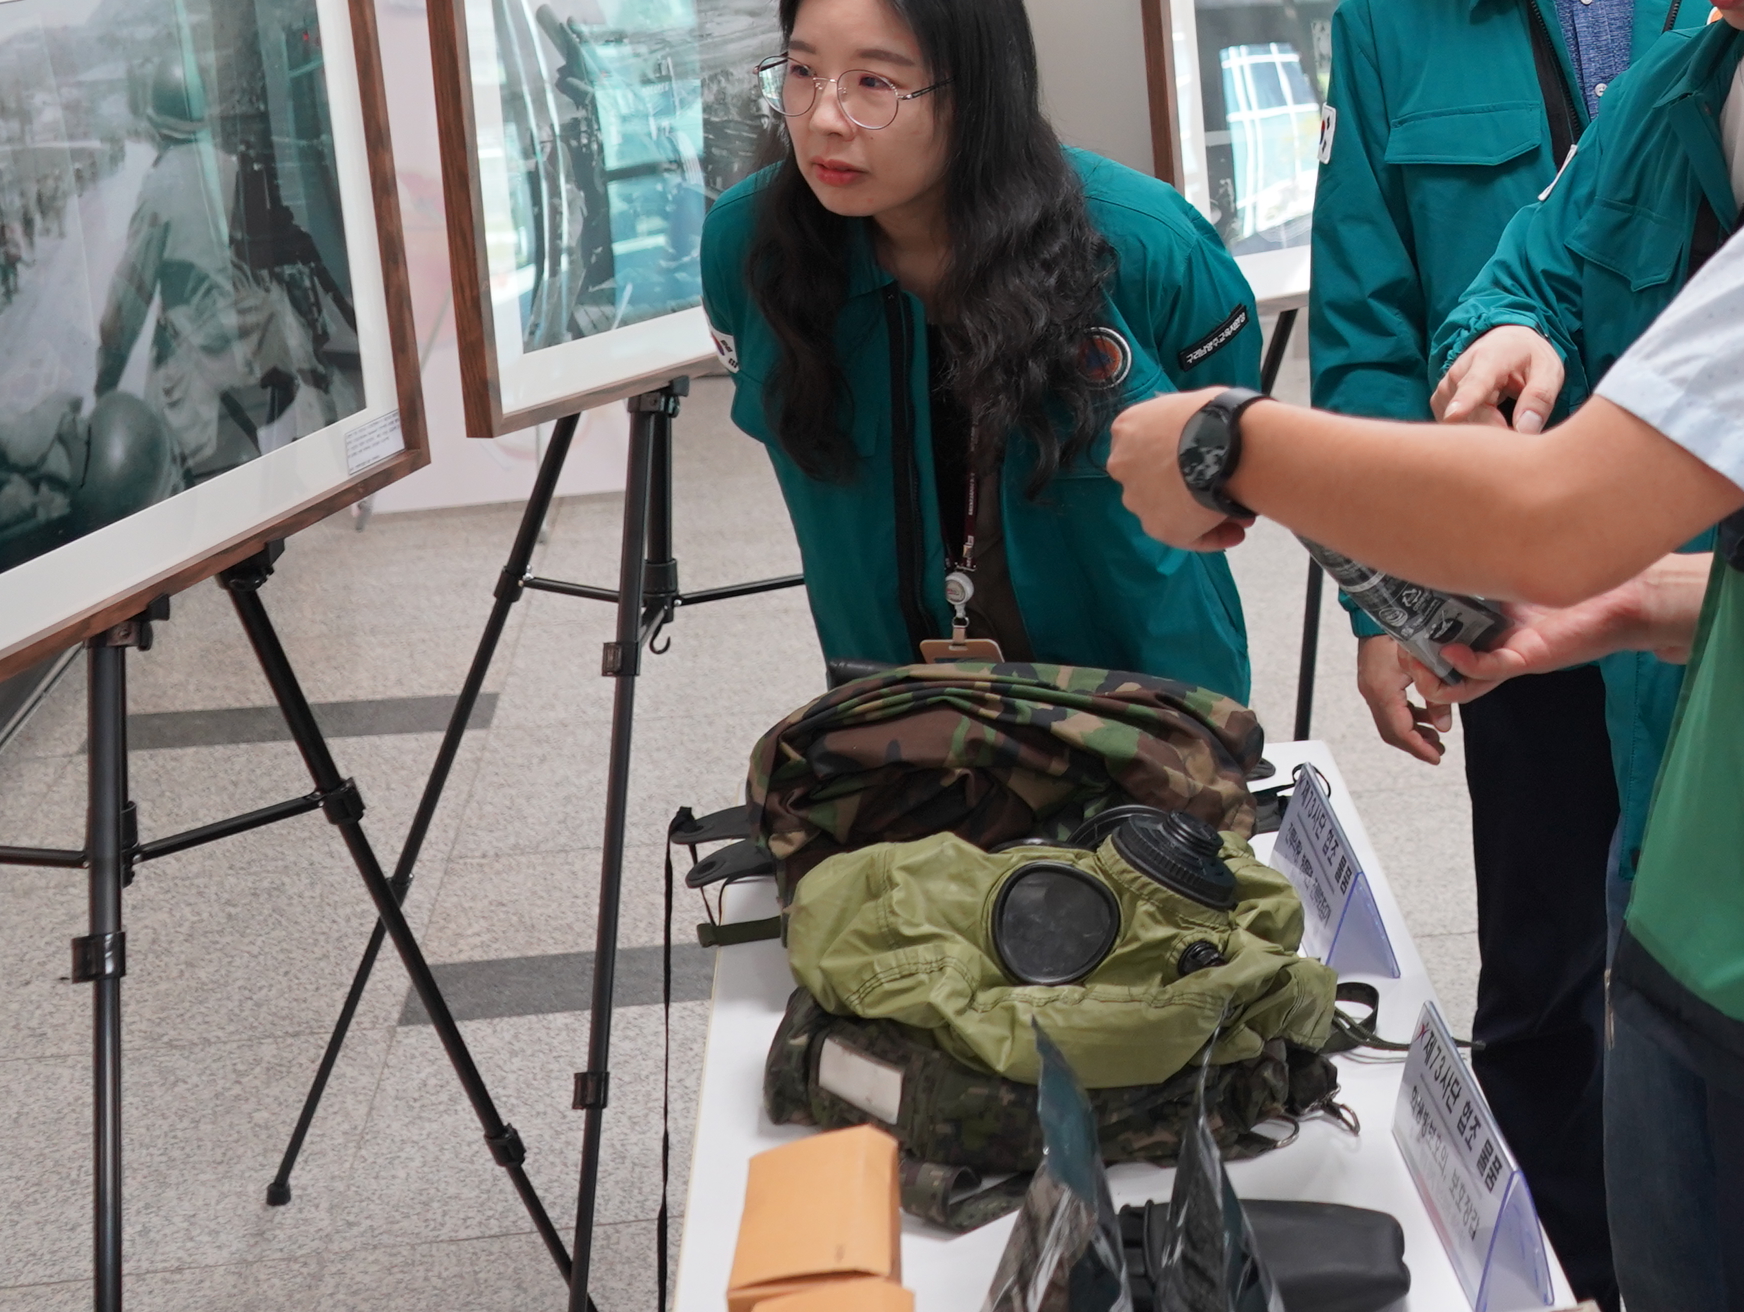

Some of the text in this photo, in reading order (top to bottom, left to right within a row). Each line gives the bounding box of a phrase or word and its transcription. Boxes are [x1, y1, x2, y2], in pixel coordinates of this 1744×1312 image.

[1335, 855, 1353, 896] 물품
[1422, 1029, 1503, 1194] 제73사단 협조 물품
